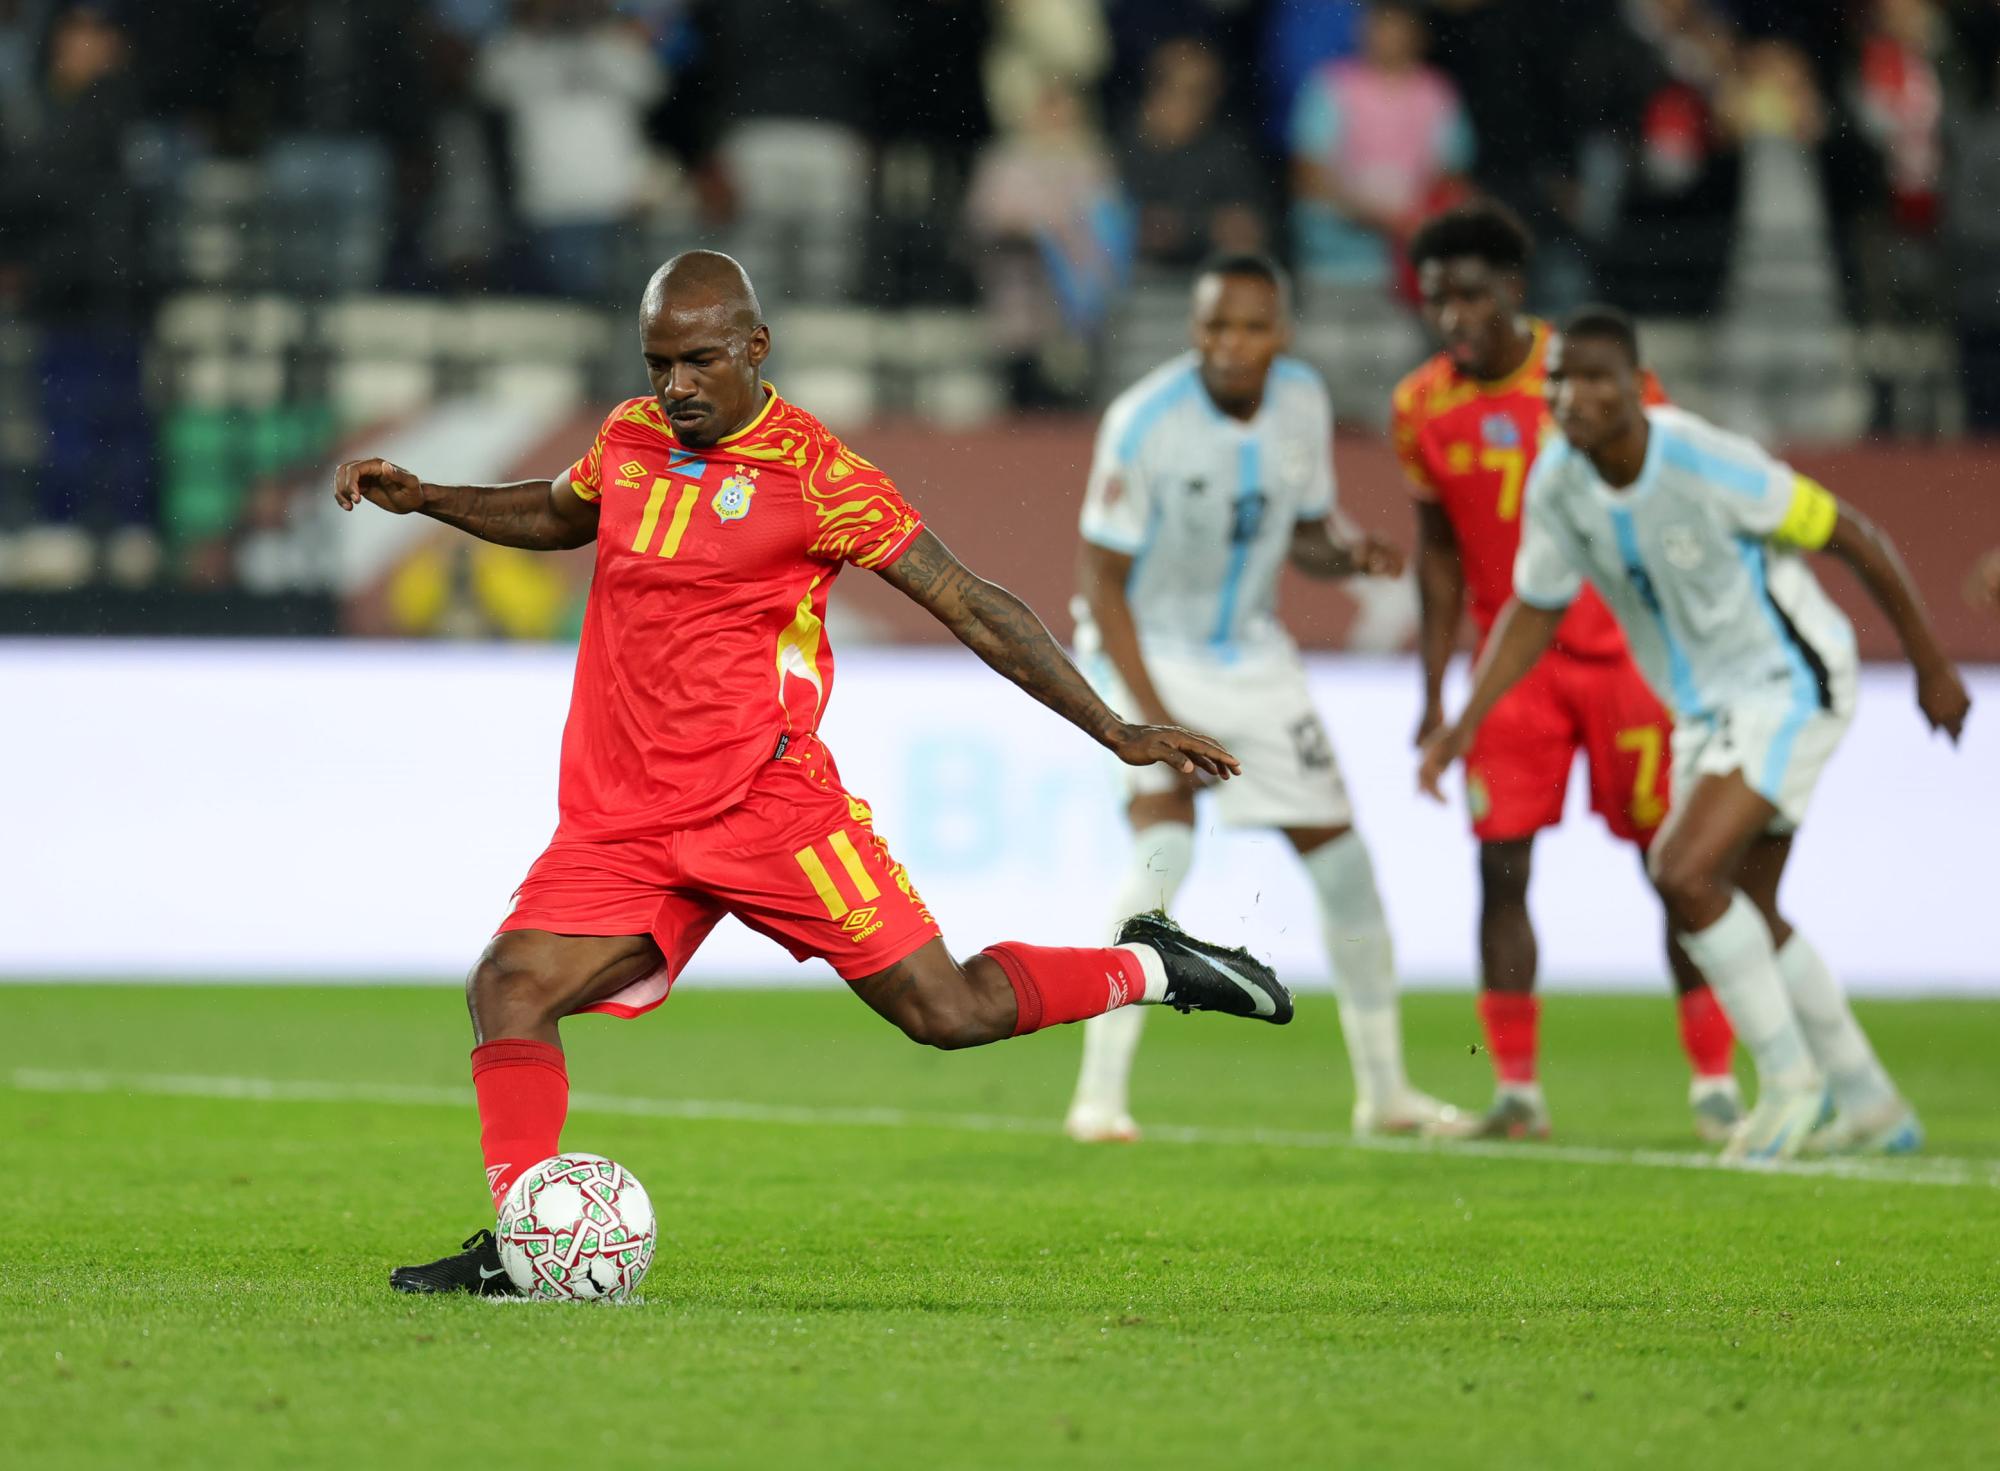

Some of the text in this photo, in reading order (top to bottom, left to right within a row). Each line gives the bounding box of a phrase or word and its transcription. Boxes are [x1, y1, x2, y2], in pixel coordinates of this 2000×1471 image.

[614, 478, 641, 490] umbro
[716, 503, 740, 517] FECOFA
[1481, 448, 1524, 520] 7
[631, 477, 701, 559] 11
[1615, 725, 1661, 810] 7
[794, 829, 882, 921] 11
[851, 919, 884, 943] umbro
[1117, 970, 1129, 1007] mbro
